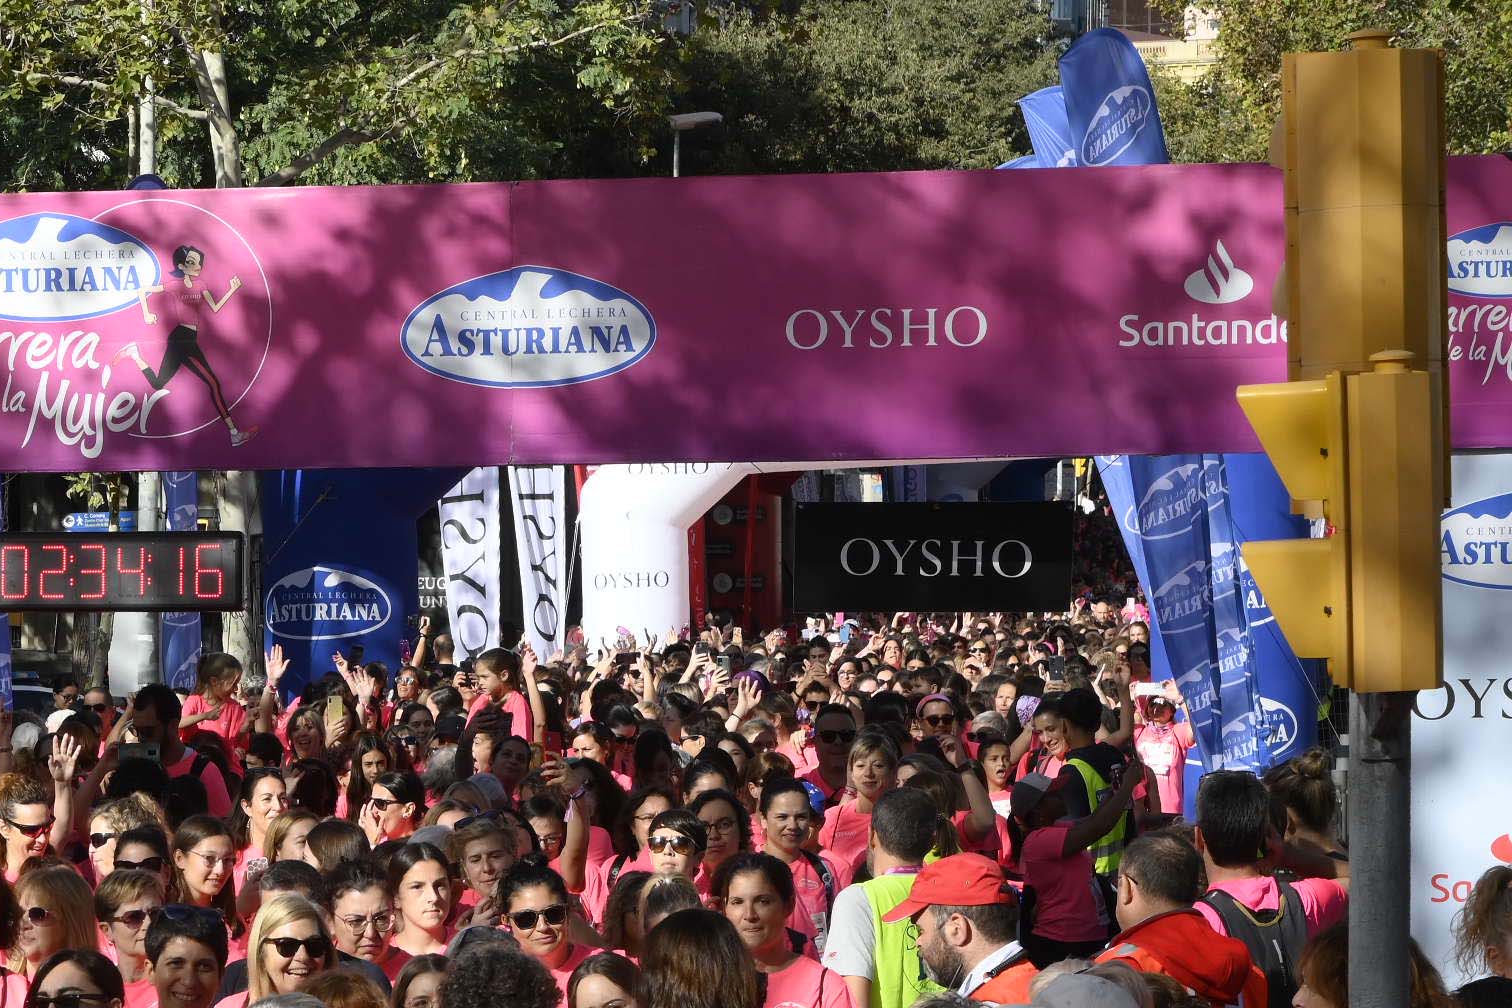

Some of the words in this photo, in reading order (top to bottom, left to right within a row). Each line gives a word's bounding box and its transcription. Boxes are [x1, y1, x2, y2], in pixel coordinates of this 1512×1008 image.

[64, 249, 136, 260] LECHERA
[460, 308, 538, 322] CENTRAL
[546, 306, 628, 319] LECHERA
[785, 305, 989, 350] OYSHO
[1119, 312, 1288, 347] Santande
[420, 312, 636, 358] ASTURIANA
[0, 372, 26, 413] la
[20, 364, 171, 459] Mujer
[0, 543, 223, 600] 02:34:16
[839, 537, 1034, 579] OYSHO
[593, 570, 670, 589] OYSHO
[269, 596, 382, 625] ASTURIANA
